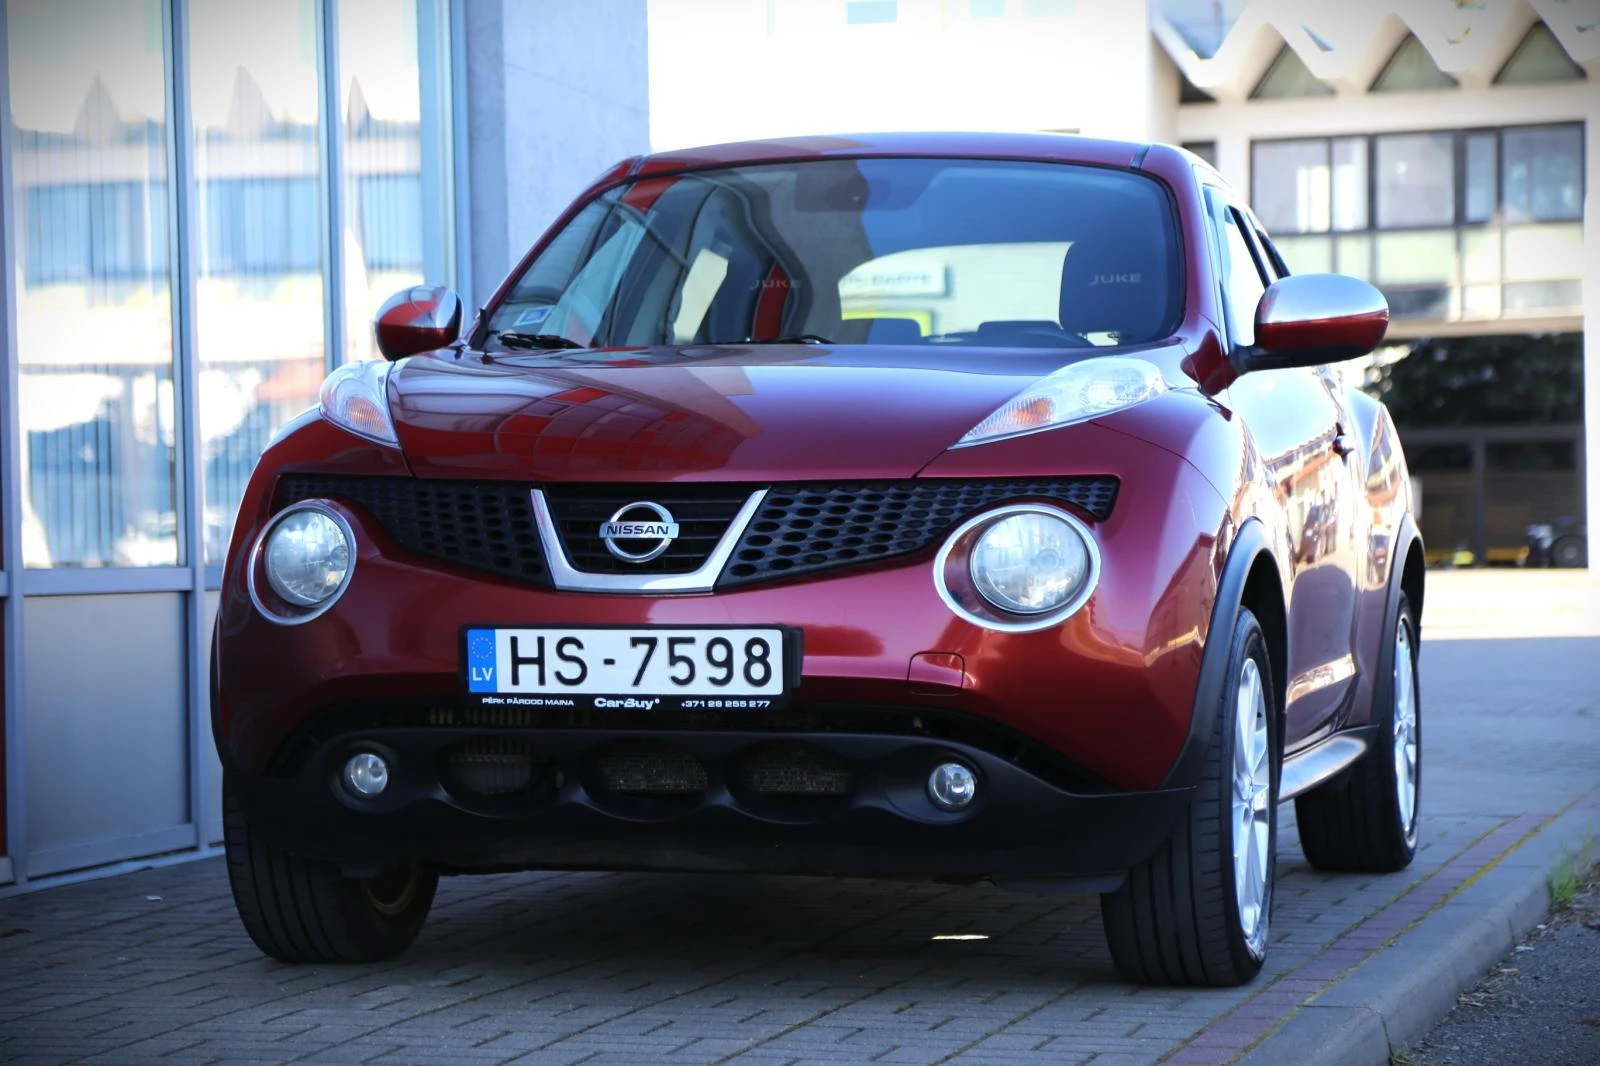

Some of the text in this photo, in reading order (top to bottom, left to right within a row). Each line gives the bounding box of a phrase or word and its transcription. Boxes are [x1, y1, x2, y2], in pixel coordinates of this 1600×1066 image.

[1088, 273, 1142, 287] JUKE
[606, 525, 669, 535] NISSAN
[509, 635, 772, 687] HS-7598
[472, 667, 494, 681] LV
[681, 700, 705, 708] +371
[748, 700, 771, 708] 277
